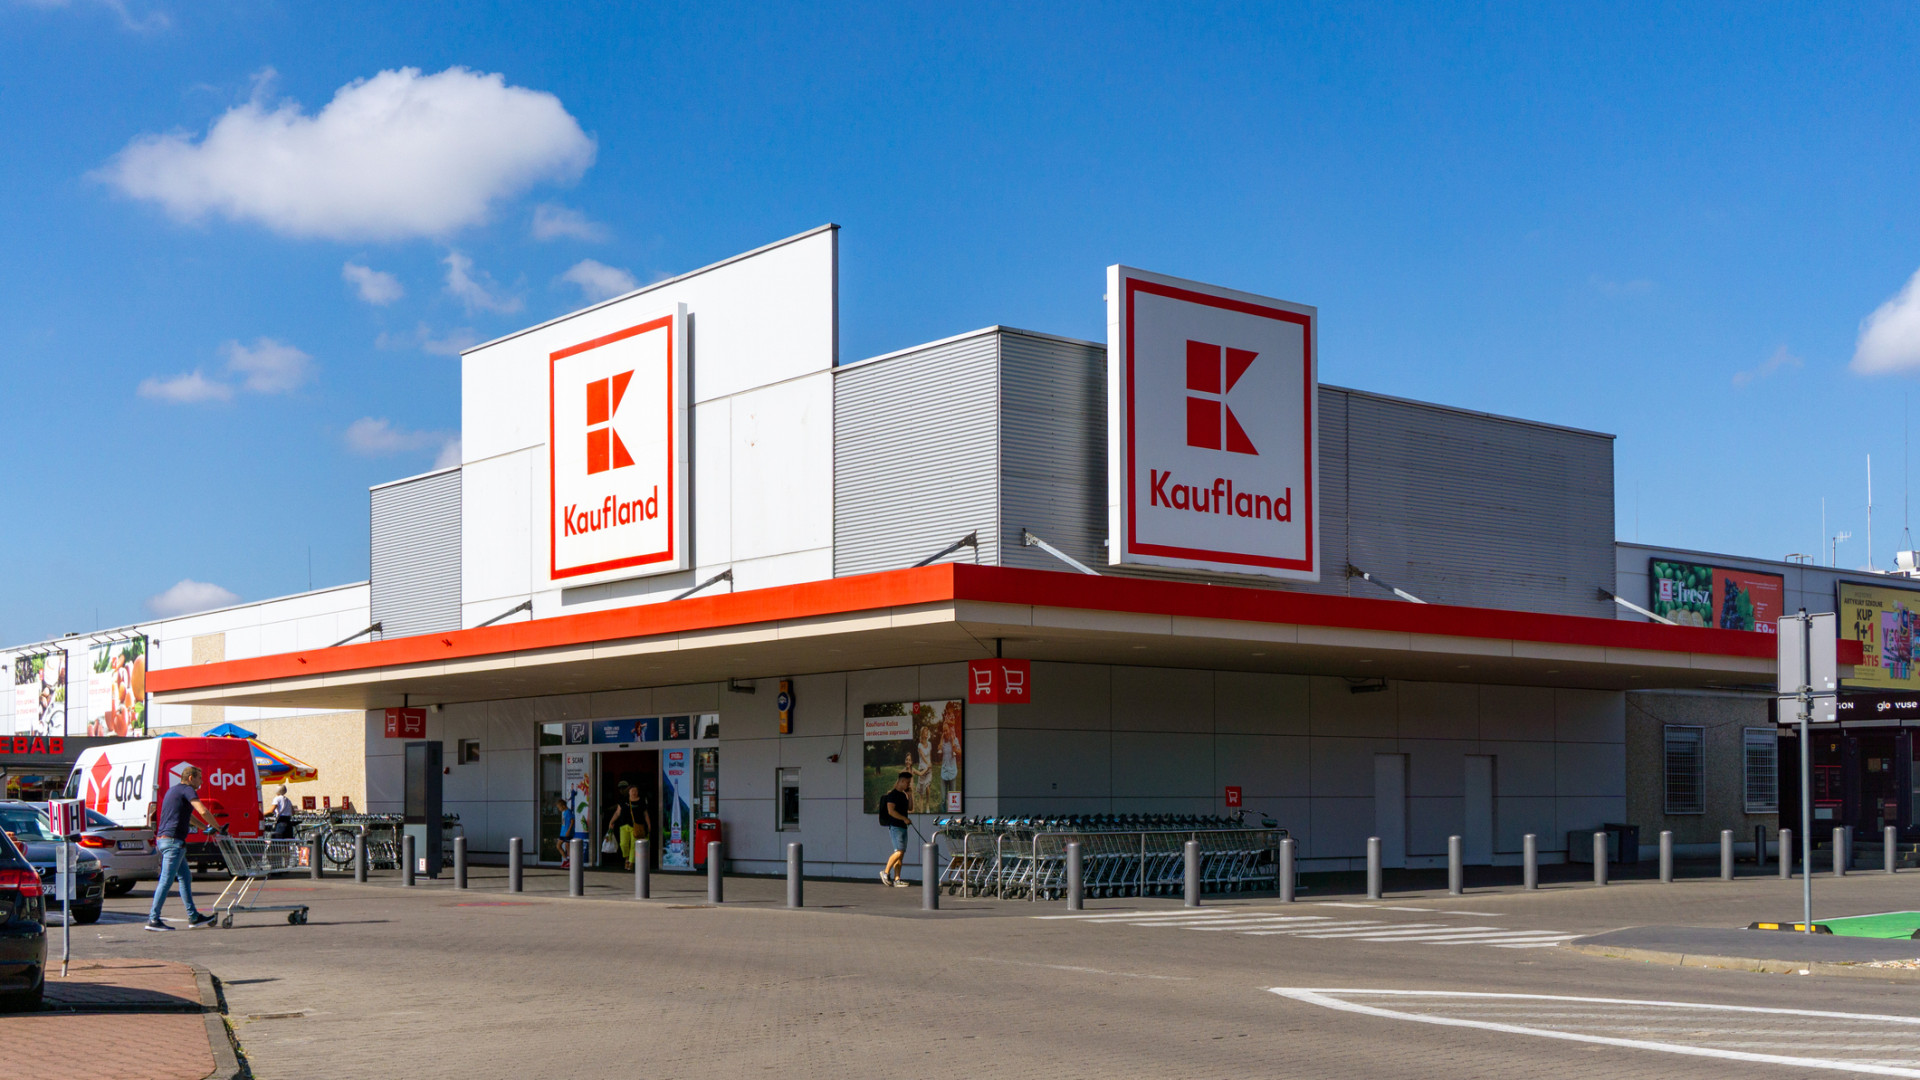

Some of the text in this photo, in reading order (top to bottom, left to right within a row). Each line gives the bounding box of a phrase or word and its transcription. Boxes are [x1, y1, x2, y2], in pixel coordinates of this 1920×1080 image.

[1150, 468, 1292, 523] Kaufland
[564, 485, 658, 538] Kaufland
[1856, 608, 1873, 621] KUP
[1853, 621, 1875, 643] 1+1
[1877, 701, 1891, 712] glo
[115, 763, 146, 811] dpd
[209, 768, 246, 791] dpd
[69, 804, 80, 831] H
